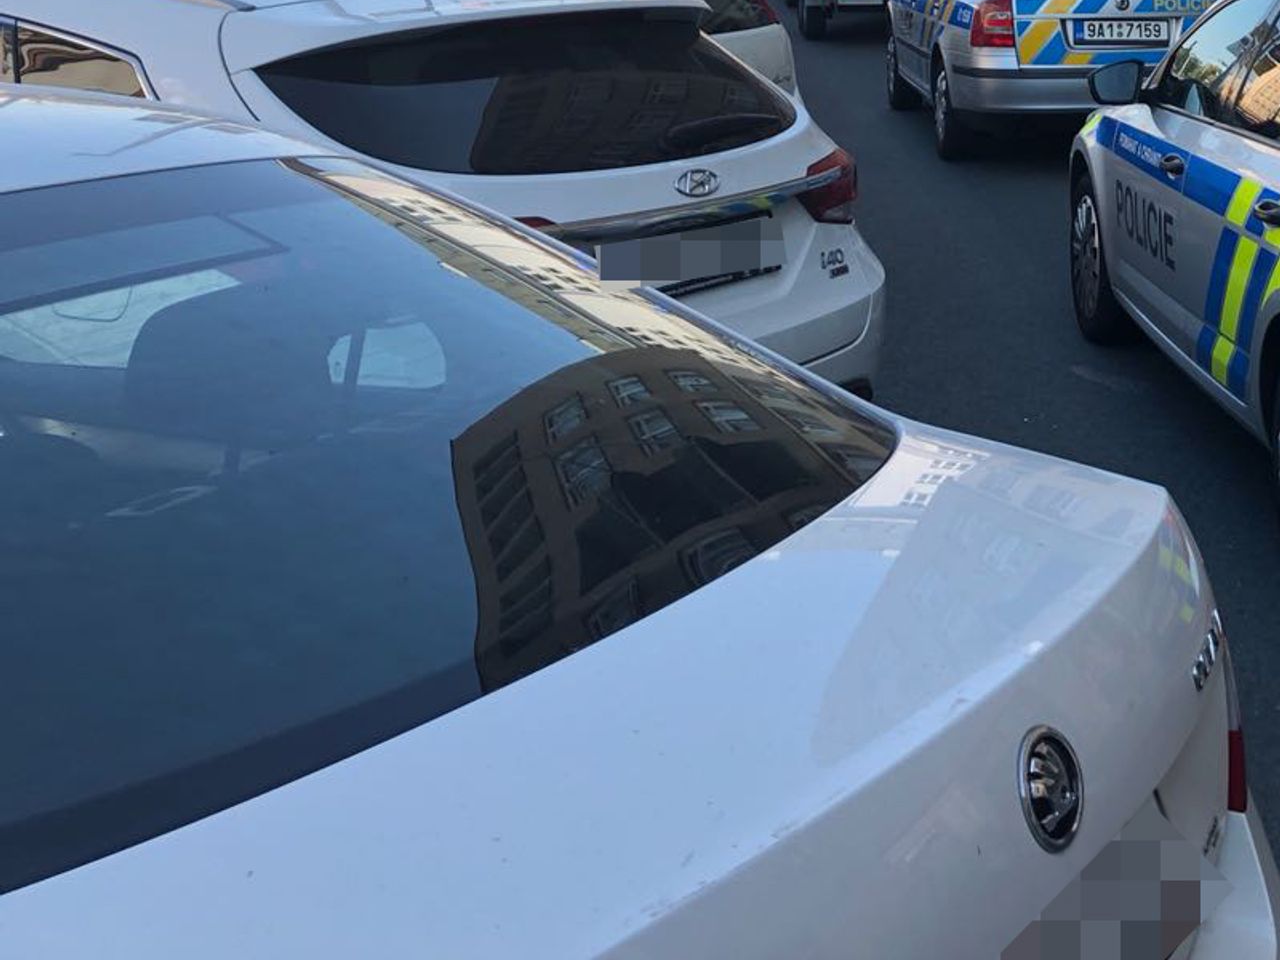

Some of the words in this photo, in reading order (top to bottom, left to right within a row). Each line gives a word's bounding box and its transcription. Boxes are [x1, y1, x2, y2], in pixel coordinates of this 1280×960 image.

[1087, 22, 1114, 38] 9A1
[1126, 22, 1162, 38] 7159
[1115, 178, 1176, 272] POLICIE
[820, 248, 845, 270] i40
